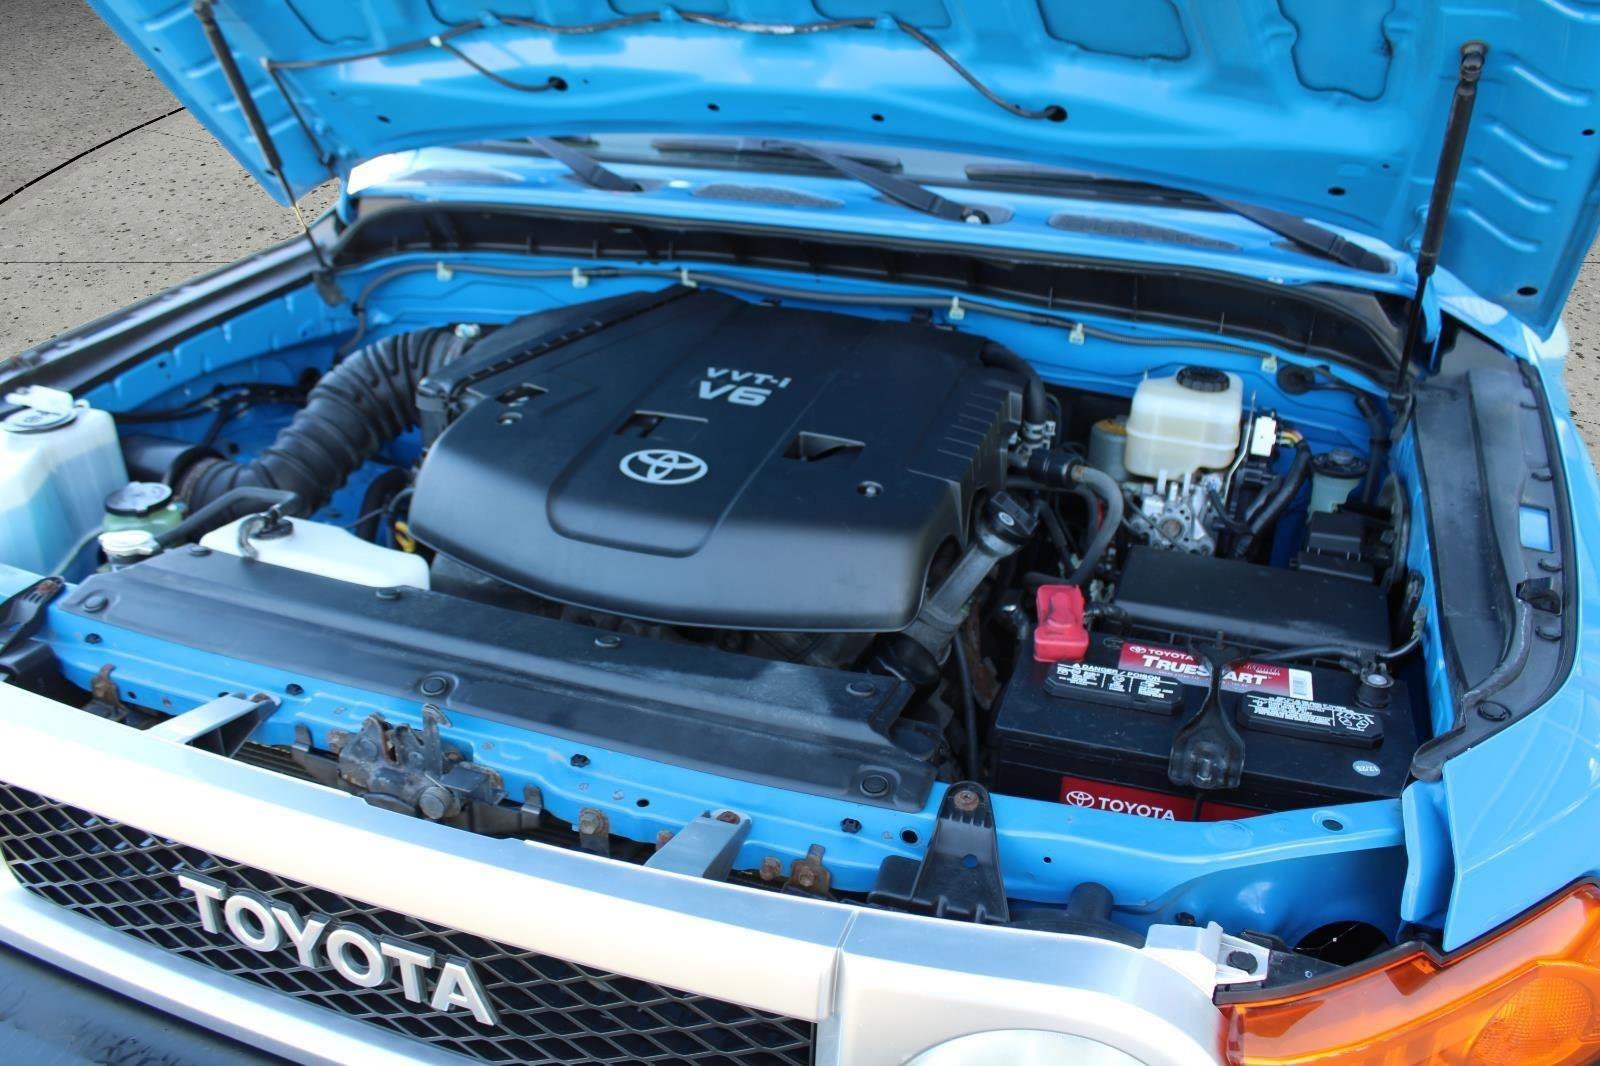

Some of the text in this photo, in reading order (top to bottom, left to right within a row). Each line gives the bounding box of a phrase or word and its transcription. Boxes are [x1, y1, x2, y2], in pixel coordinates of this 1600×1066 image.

[699, 380, 773, 407] V6
[1148, 648, 1194, 661] TOYOTA
[1081, 664, 1119, 675] DANGER
[1127, 671, 1161, 681] POISON
[1142, 654, 1268, 686] TRUESART
[1098, 796, 1176, 821] TOYOTA
[178, 869, 499, 1027] TOYOTA
